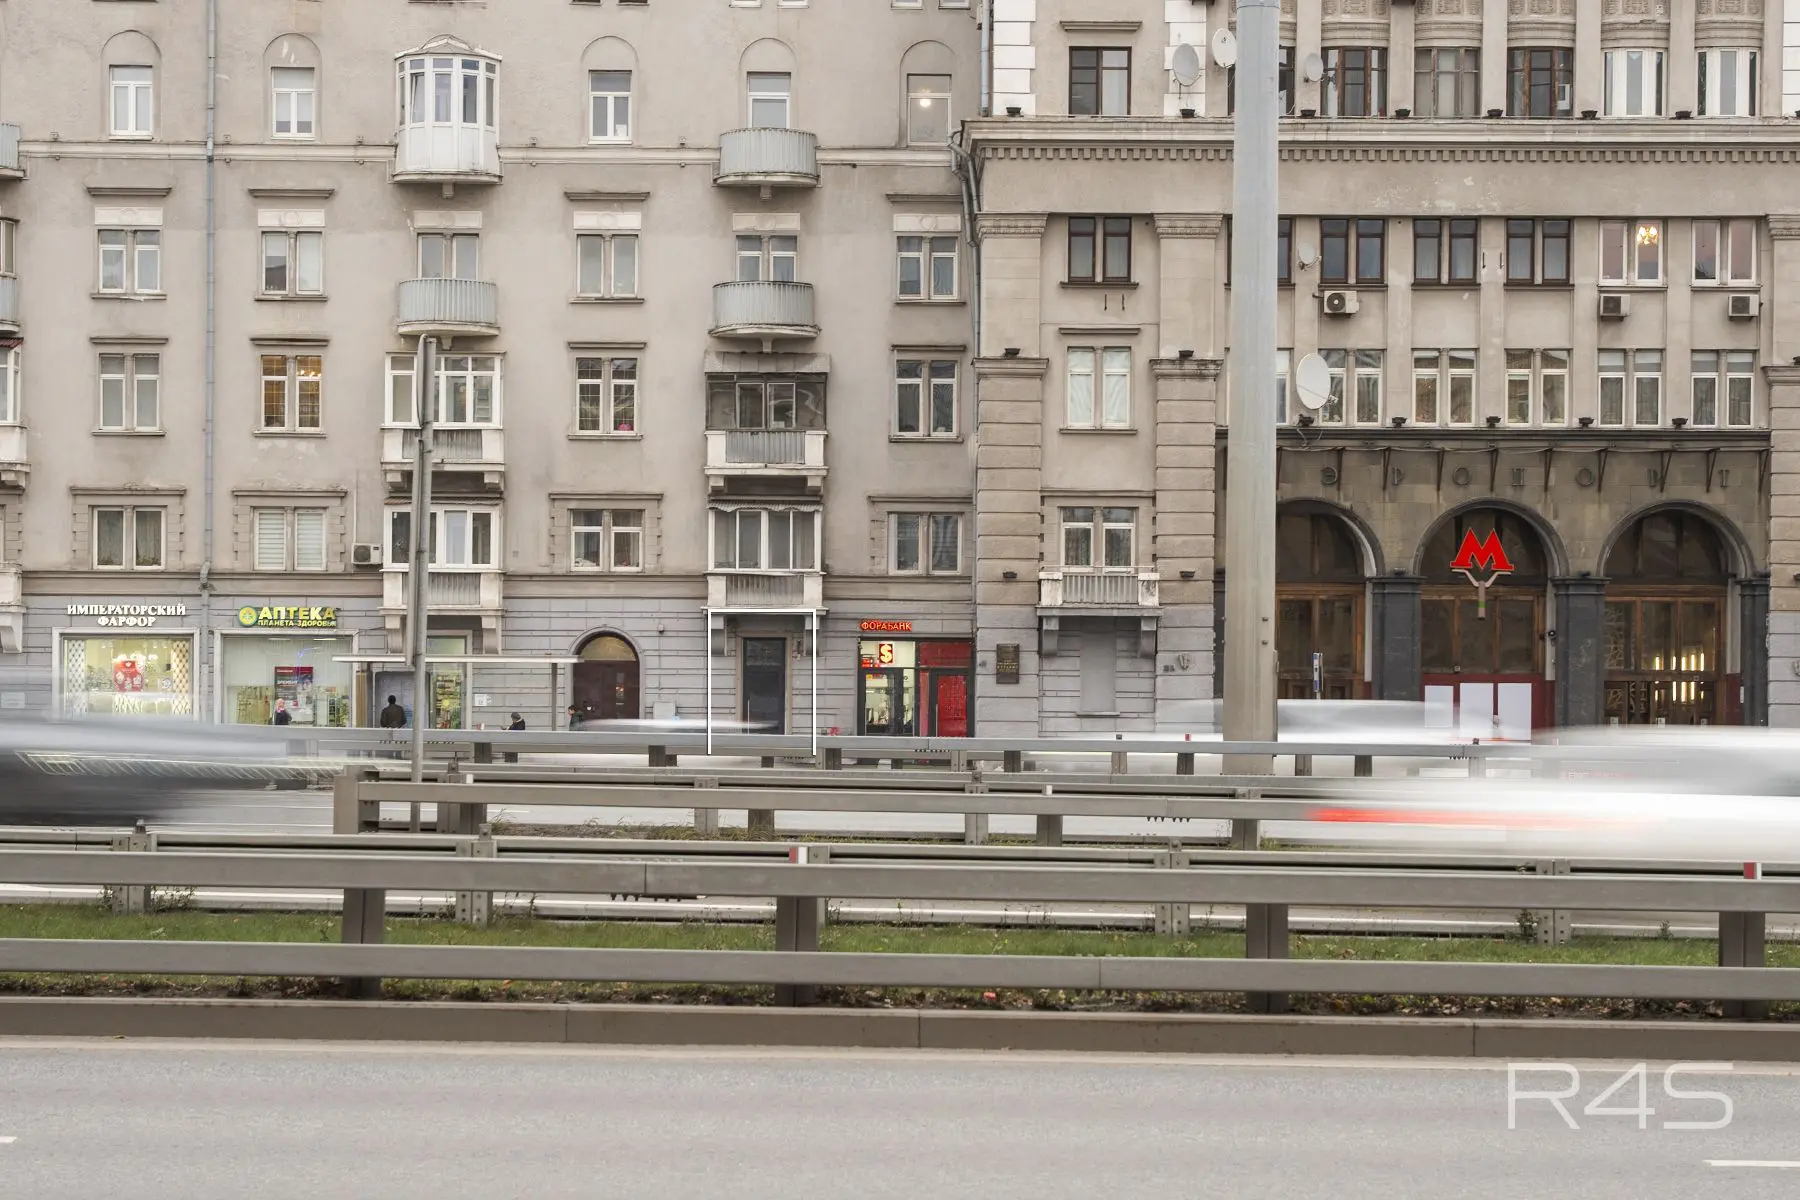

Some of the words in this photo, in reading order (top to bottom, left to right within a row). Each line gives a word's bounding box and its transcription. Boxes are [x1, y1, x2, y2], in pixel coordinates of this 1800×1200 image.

[1319, 465, 1731, 489] ЭРОПОРТ
[1450, 527, 1515, 571] М
[67, 603, 186, 616] ИМПЕРАТОРСКИЙ
[258, 606, 336, 620] АПТЕКА
[97, 616, 157, 627] ФАРФОР
[297, 620, 337, 628] ЗДОРОВЬЯ
